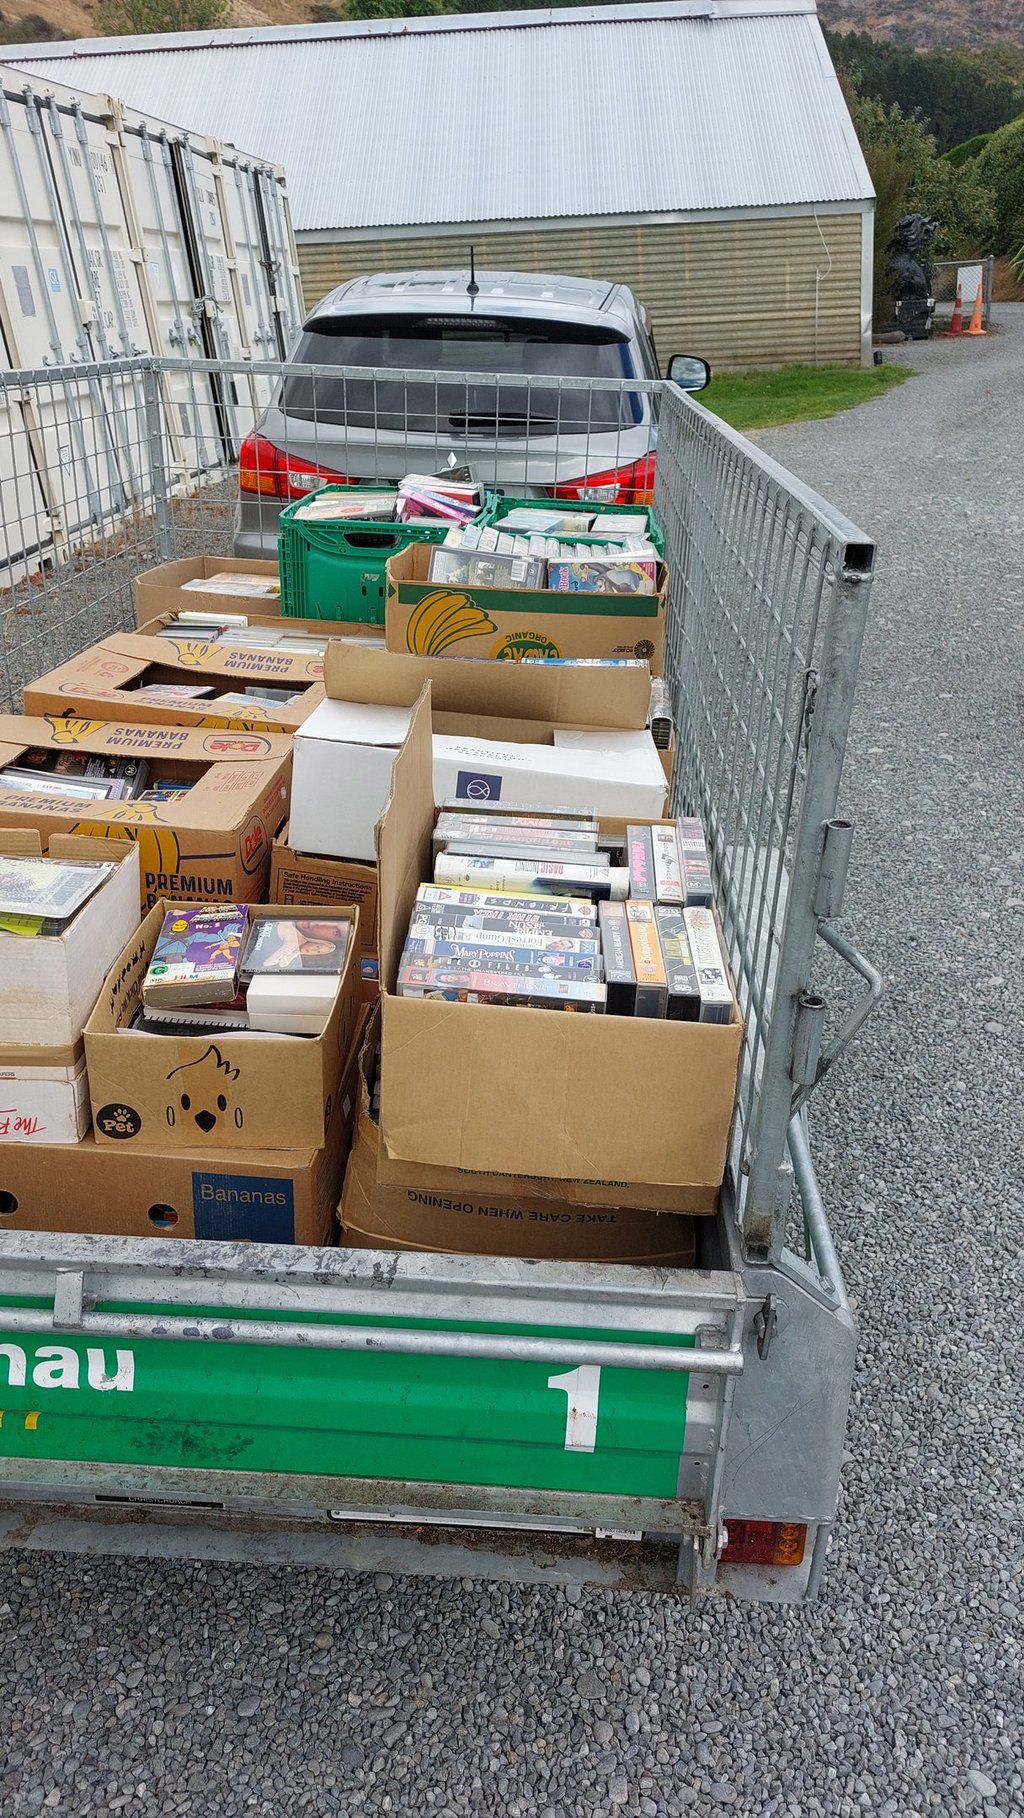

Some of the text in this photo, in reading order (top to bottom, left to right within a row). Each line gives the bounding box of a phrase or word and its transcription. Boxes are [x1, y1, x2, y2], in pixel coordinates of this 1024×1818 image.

[504, 631, 548, 644] ORGANIC
[223, 659, 290, 673] PREMIUM
[229, 651, 294, 666] BANANAS
[113, 727, 190, 741] BANANAS
[105, 736, 183, 750] PREMIUM
[209, 741, 262, 752] Dole
[4, 794, 93, 809] PREMIUM
[243, 824, 263, 859] Dole
[540, 862, 565, 876] BASIC
[145, 872, 233, 896] PREMIUM
[283, 871, 299, 880] Safe
[300, 874, 331, 886] Handling
[332, 879, 373, 891] Instructions
[508, 920, 535, 930] SUN
[512, 927, 553, 938] EMPIRE
[475, 931, 506, 944] Gump
[506, 935, 543, 947] Forrest
[612, 931, 625, 969] AMERICAN BEAUTY
[487, 961, 531, 973] FILES
[13, 1116, 47, 1136] The
[103, 1119, 135, 1134] Pet
[457, 1168, 490, 1176] SOUTH
[583, 1178, 630, 1188] ZEALAND.
[201, 1183, 287, 1206] Bananas
[407, 1190, 617, 1223] TAKE CARE WHEN OPENING
[548, 1364, 602, 1453] 1
